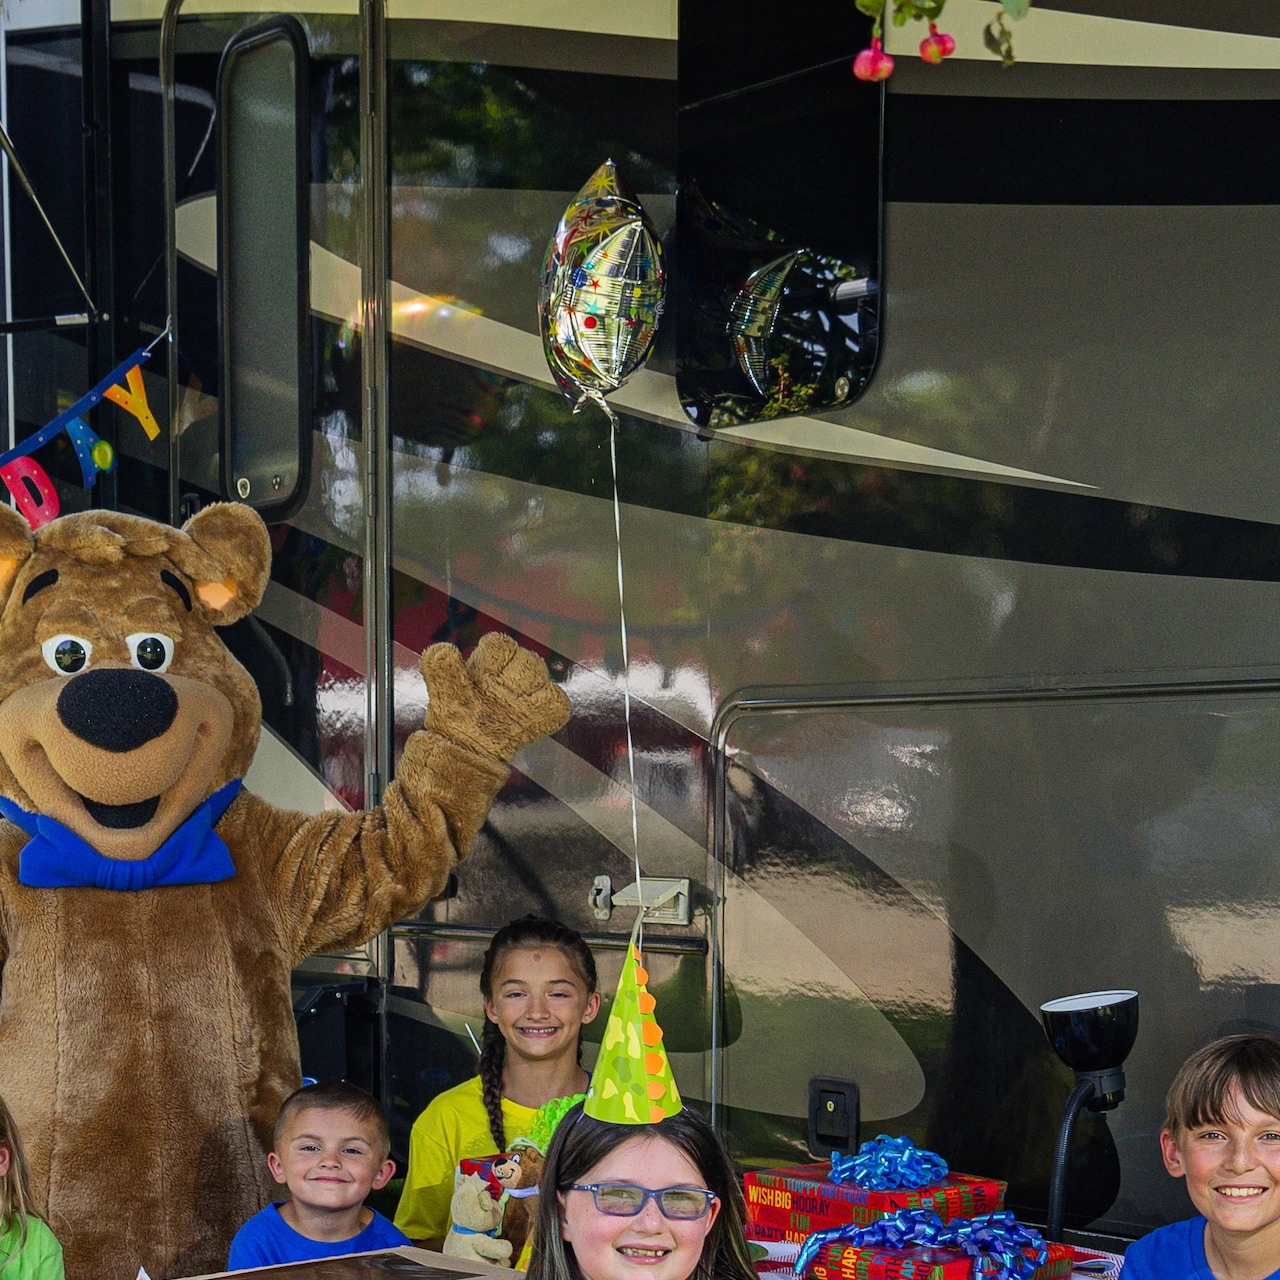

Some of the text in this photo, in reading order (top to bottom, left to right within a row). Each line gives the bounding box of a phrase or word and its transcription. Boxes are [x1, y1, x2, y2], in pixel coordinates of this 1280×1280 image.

[748, 1185, 831, 1218] WISH BIG HOORAY
[789, 1211, 810, 1232] FUN
